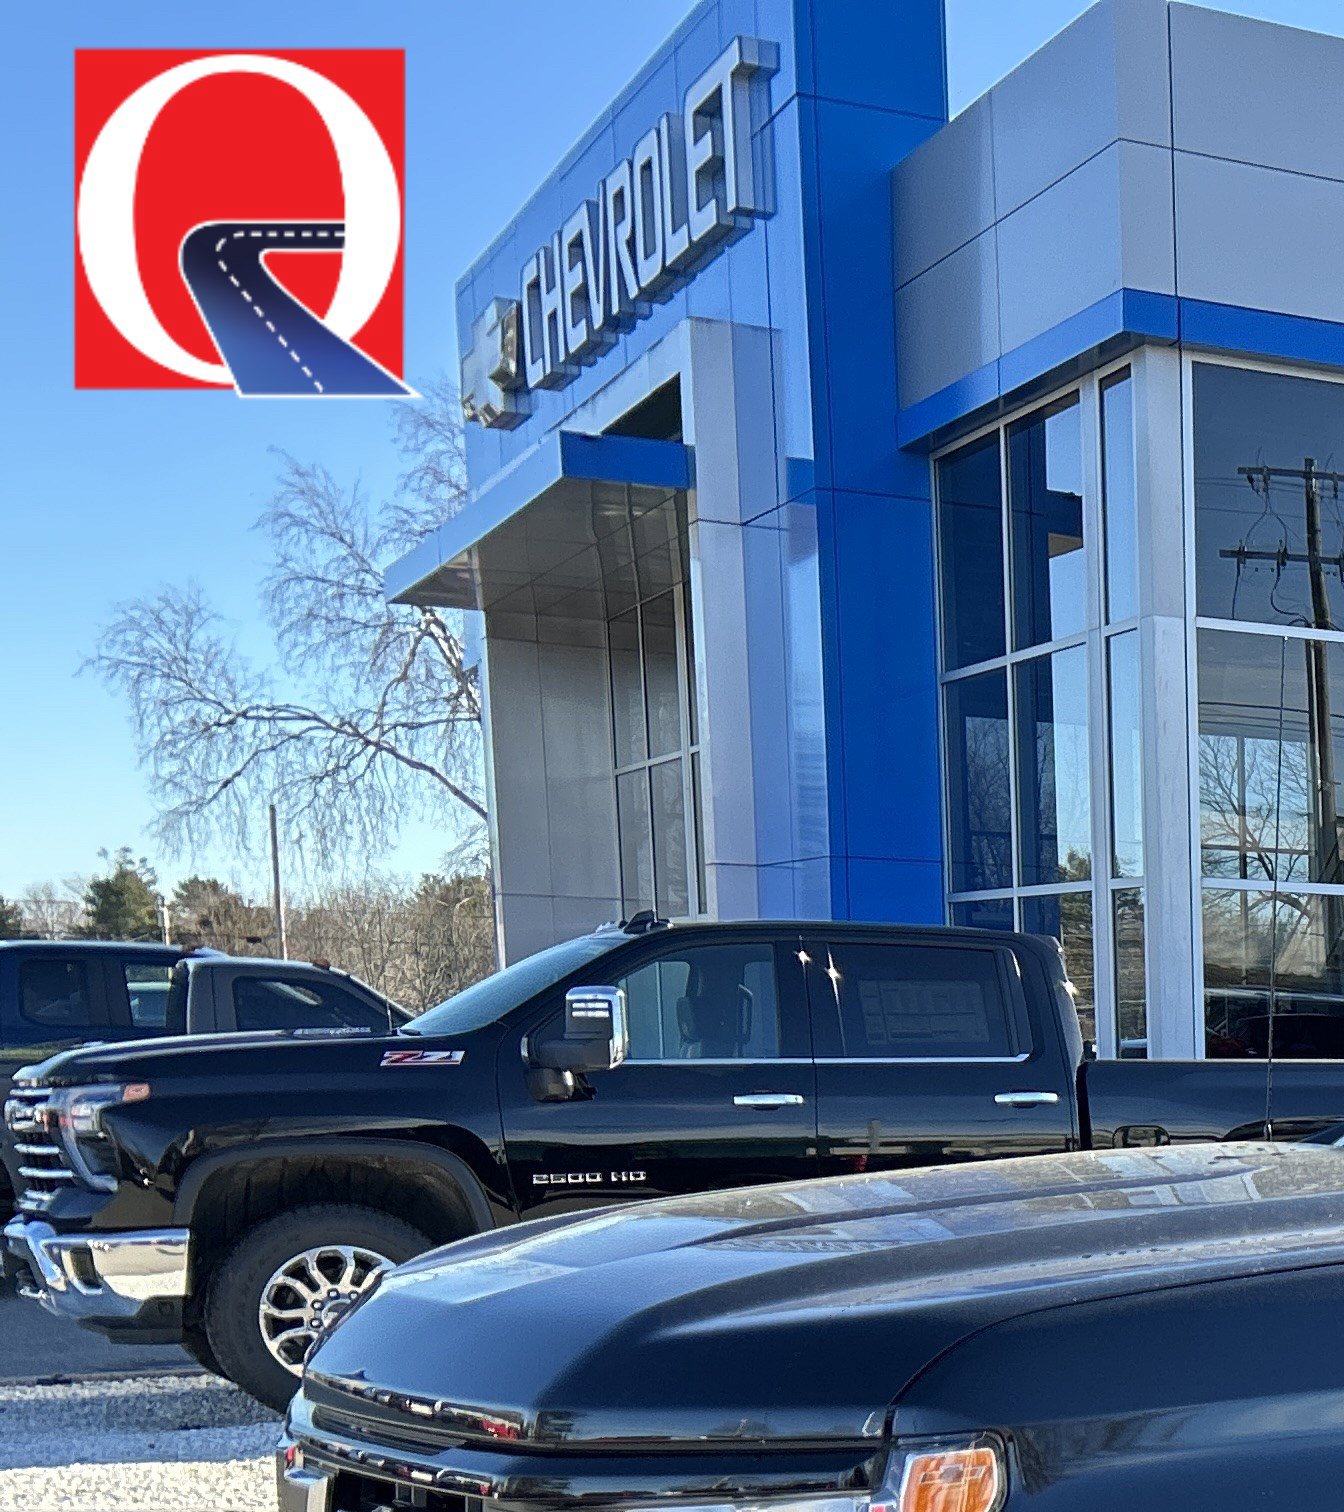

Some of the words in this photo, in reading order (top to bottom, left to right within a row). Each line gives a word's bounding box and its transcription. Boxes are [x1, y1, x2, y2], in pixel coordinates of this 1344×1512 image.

[520, 36, 776, 391] CHEVROLET
[380, 1050, 466, 1067] Z71
[532, 1171, 603, 1185] 2500
[610, 1170, 647, 1182] HD
